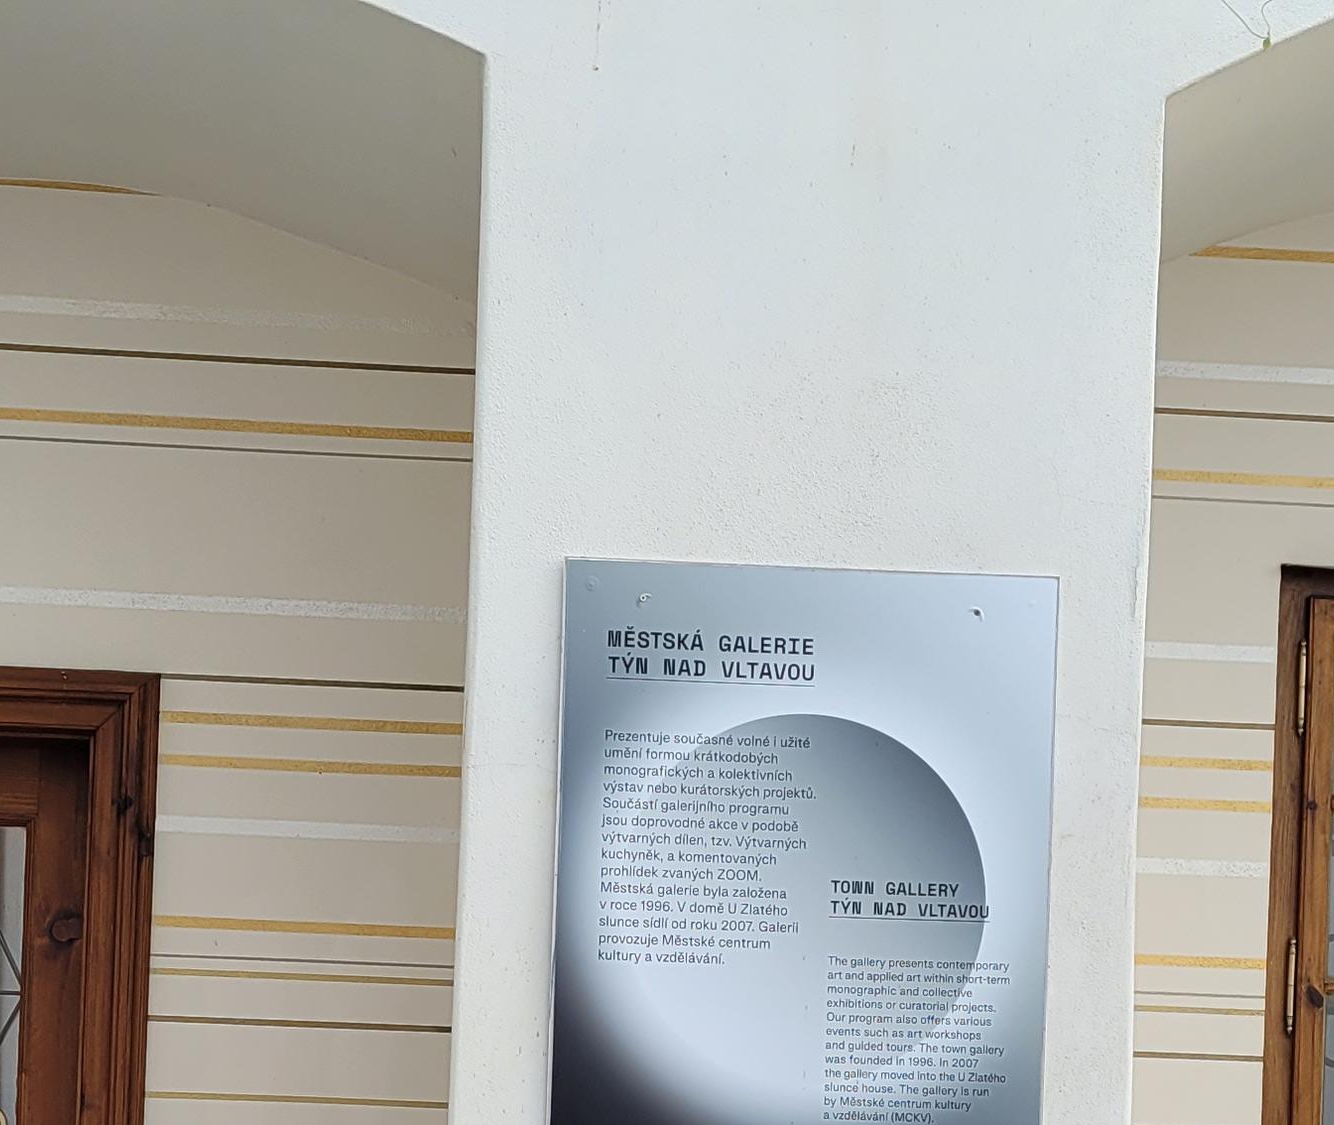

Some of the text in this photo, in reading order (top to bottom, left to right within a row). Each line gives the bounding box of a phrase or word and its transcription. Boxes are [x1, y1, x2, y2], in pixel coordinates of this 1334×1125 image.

[608, 626, 813, 655] MĚSTSKÁ GALERIE
[608, 652, 814, 680] TÝN NAD VLTAVOU
[604, 729, 811, 748] Prezentuje současné volné i užité
[604, 746, 779, 765] umění formou krátkodobých
[603, 765, 792, 781] monografických a kolektivních
[602, 780, 816, 800] výstav nebo kurátorských projektů.
[603, 796, 788, 816] Součástí galerijního programu
[601, 814, 799, 832] jsou doprovodné akce v podobě
[601, 831, 807, 851] výtvarných dílen, tzv. Výtvarných
[601, 848, 777, 866] kuchyněk, a komentovaných
[601, 865, 763, 881] prohlídek zvaných ZOOM.
[600, 881, 787, 899] Městská galerie byla založena
[831, 879, 958, 897] TOWN GALLERY
[599, 900, 788, 916] v roce 1996. V domě U Zlatého
[830, 898, 989, 918] TÝN NAD VLTAVOU
[598, 915, 799, 933] slunce sídlí od roku 2007. Galerii
[598, 934, 771, 949] provozuje Městské centrum
[597, 949, 725, 964] kultury a vzdělávání.
[828, 955, 1010, 973] The gallery presents contemporary
[827, 970, 1010, 984] art and applied art within short-term
[827, 984, 972, 998] monographic and collective
[826, 997, 997, 1014] exhibitions or curatorial projects.
[826, 1011, 993, 1027] Our program also offers various
[826, 1027, 981, 1041] events such as art workshops
[825, 1040, 1004, 1057] and guided tours. The town gallery
[824, 1054, 979, 1070] was founded in 1996. In 2007
[825, 1067, 1006, 1085] the gallery moved into the U Zlatého
[823, 1081, 989, 1098] slunce house. The gallery is run
[823, 1095, 971, 1112] by Městské centrum kultury
[823, 1110, 934, 1125] a vzdělávání (MCKV).
